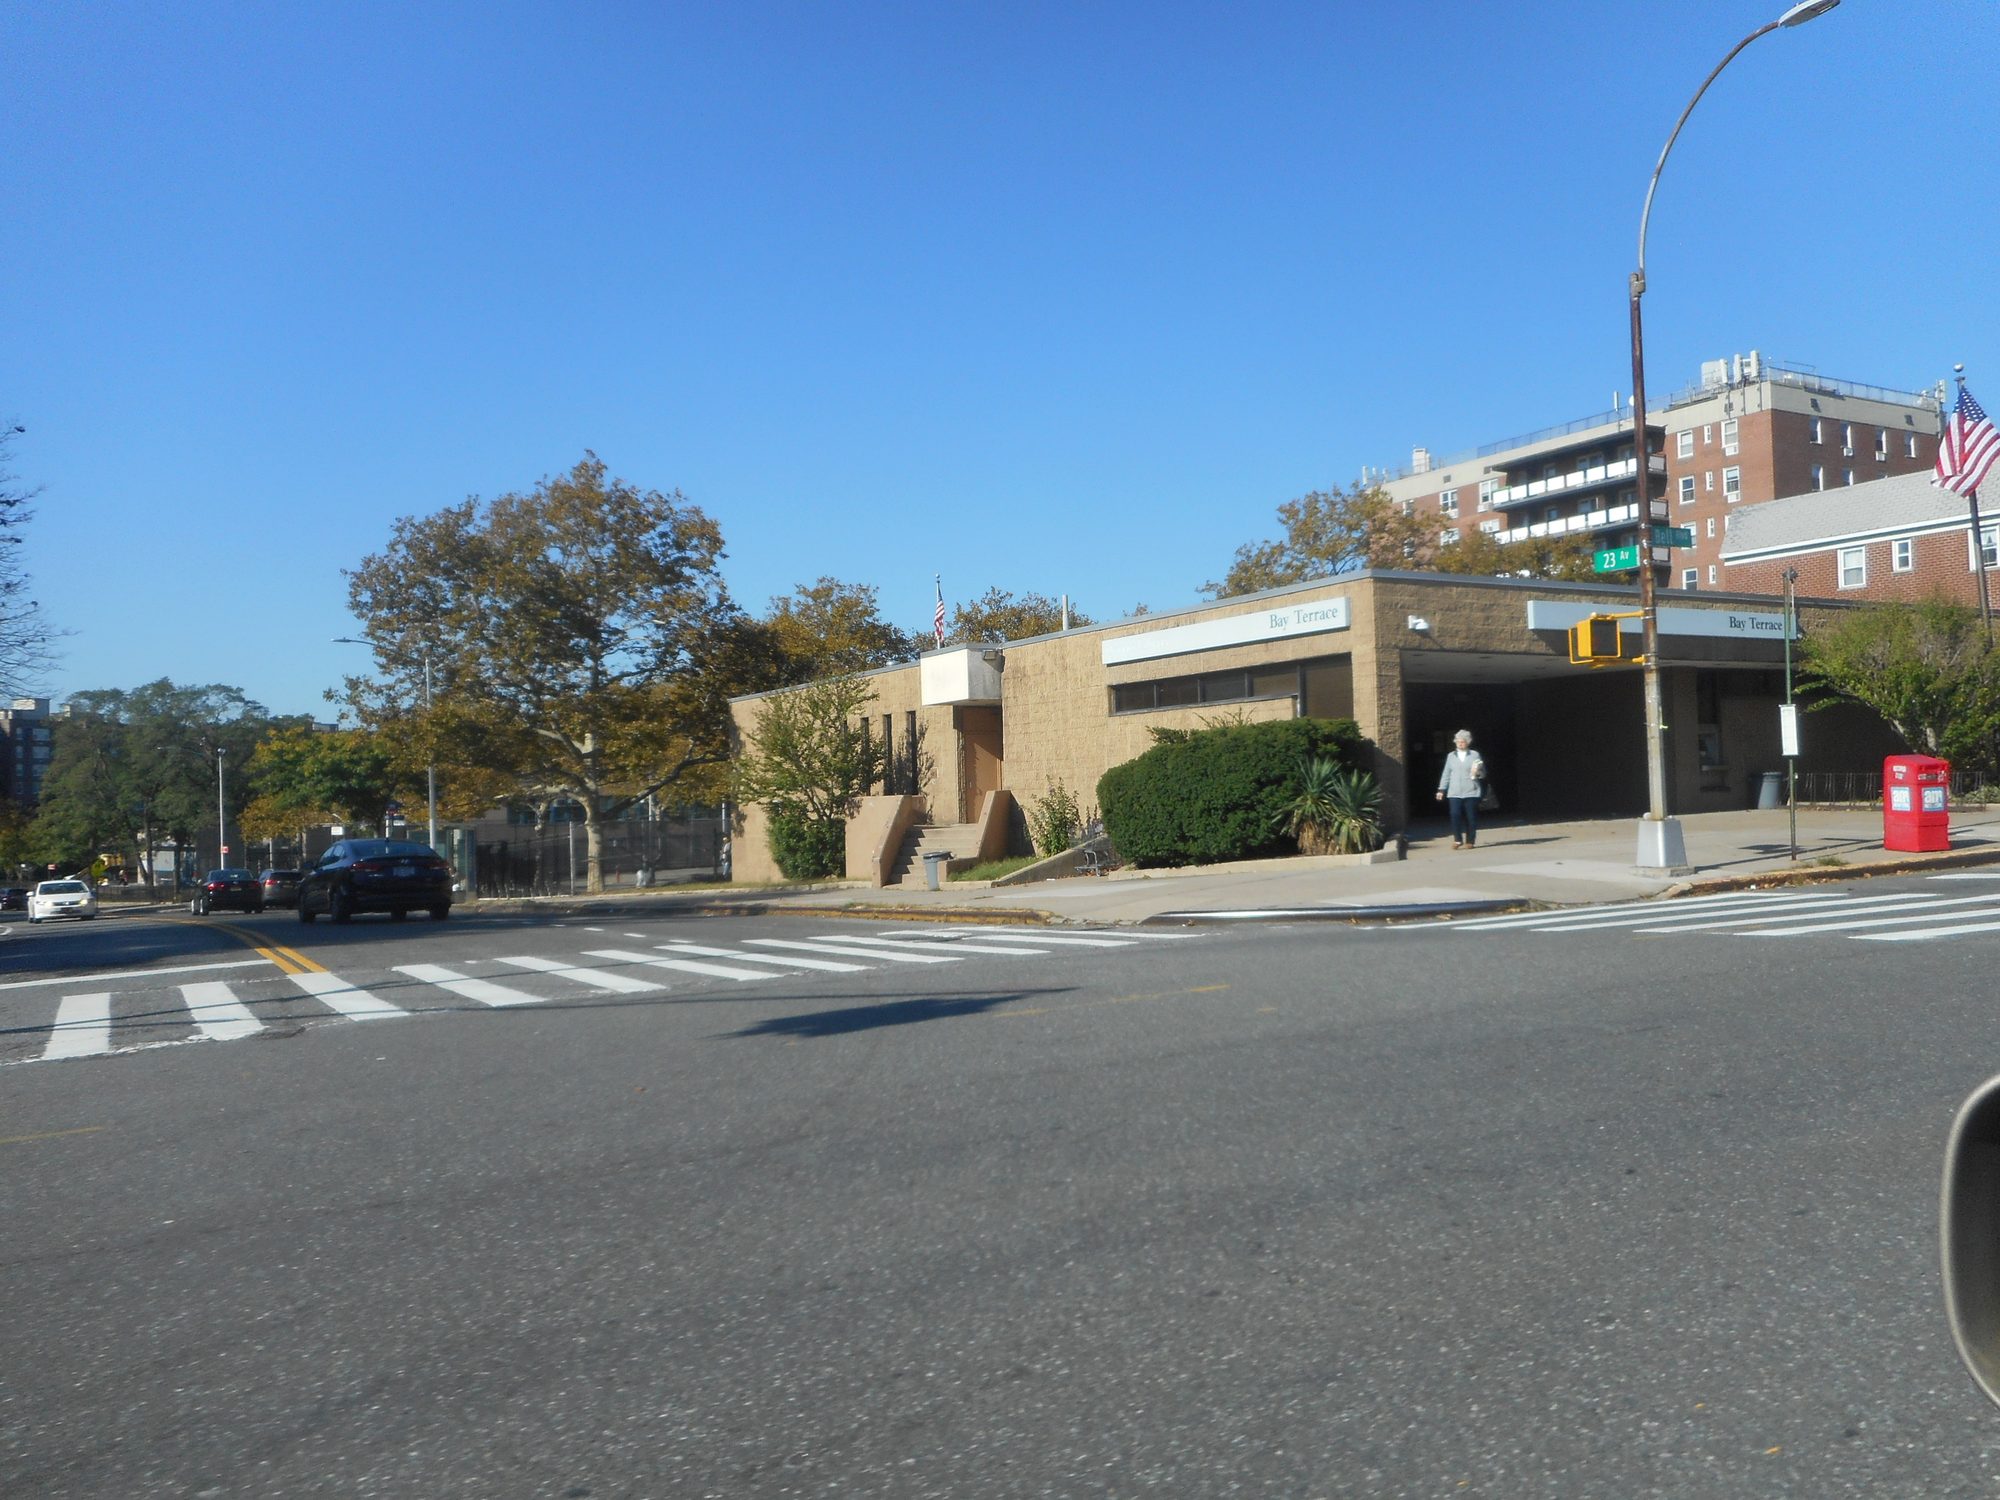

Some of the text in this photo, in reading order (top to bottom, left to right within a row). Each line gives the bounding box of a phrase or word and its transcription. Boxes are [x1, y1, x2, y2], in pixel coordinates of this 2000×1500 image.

[1603, 550, 1629, 568] 23 Av
[1269, 607, 1338, 630] Bay Terrace
[1729, 616, 1783, 631] Bay Terrace
